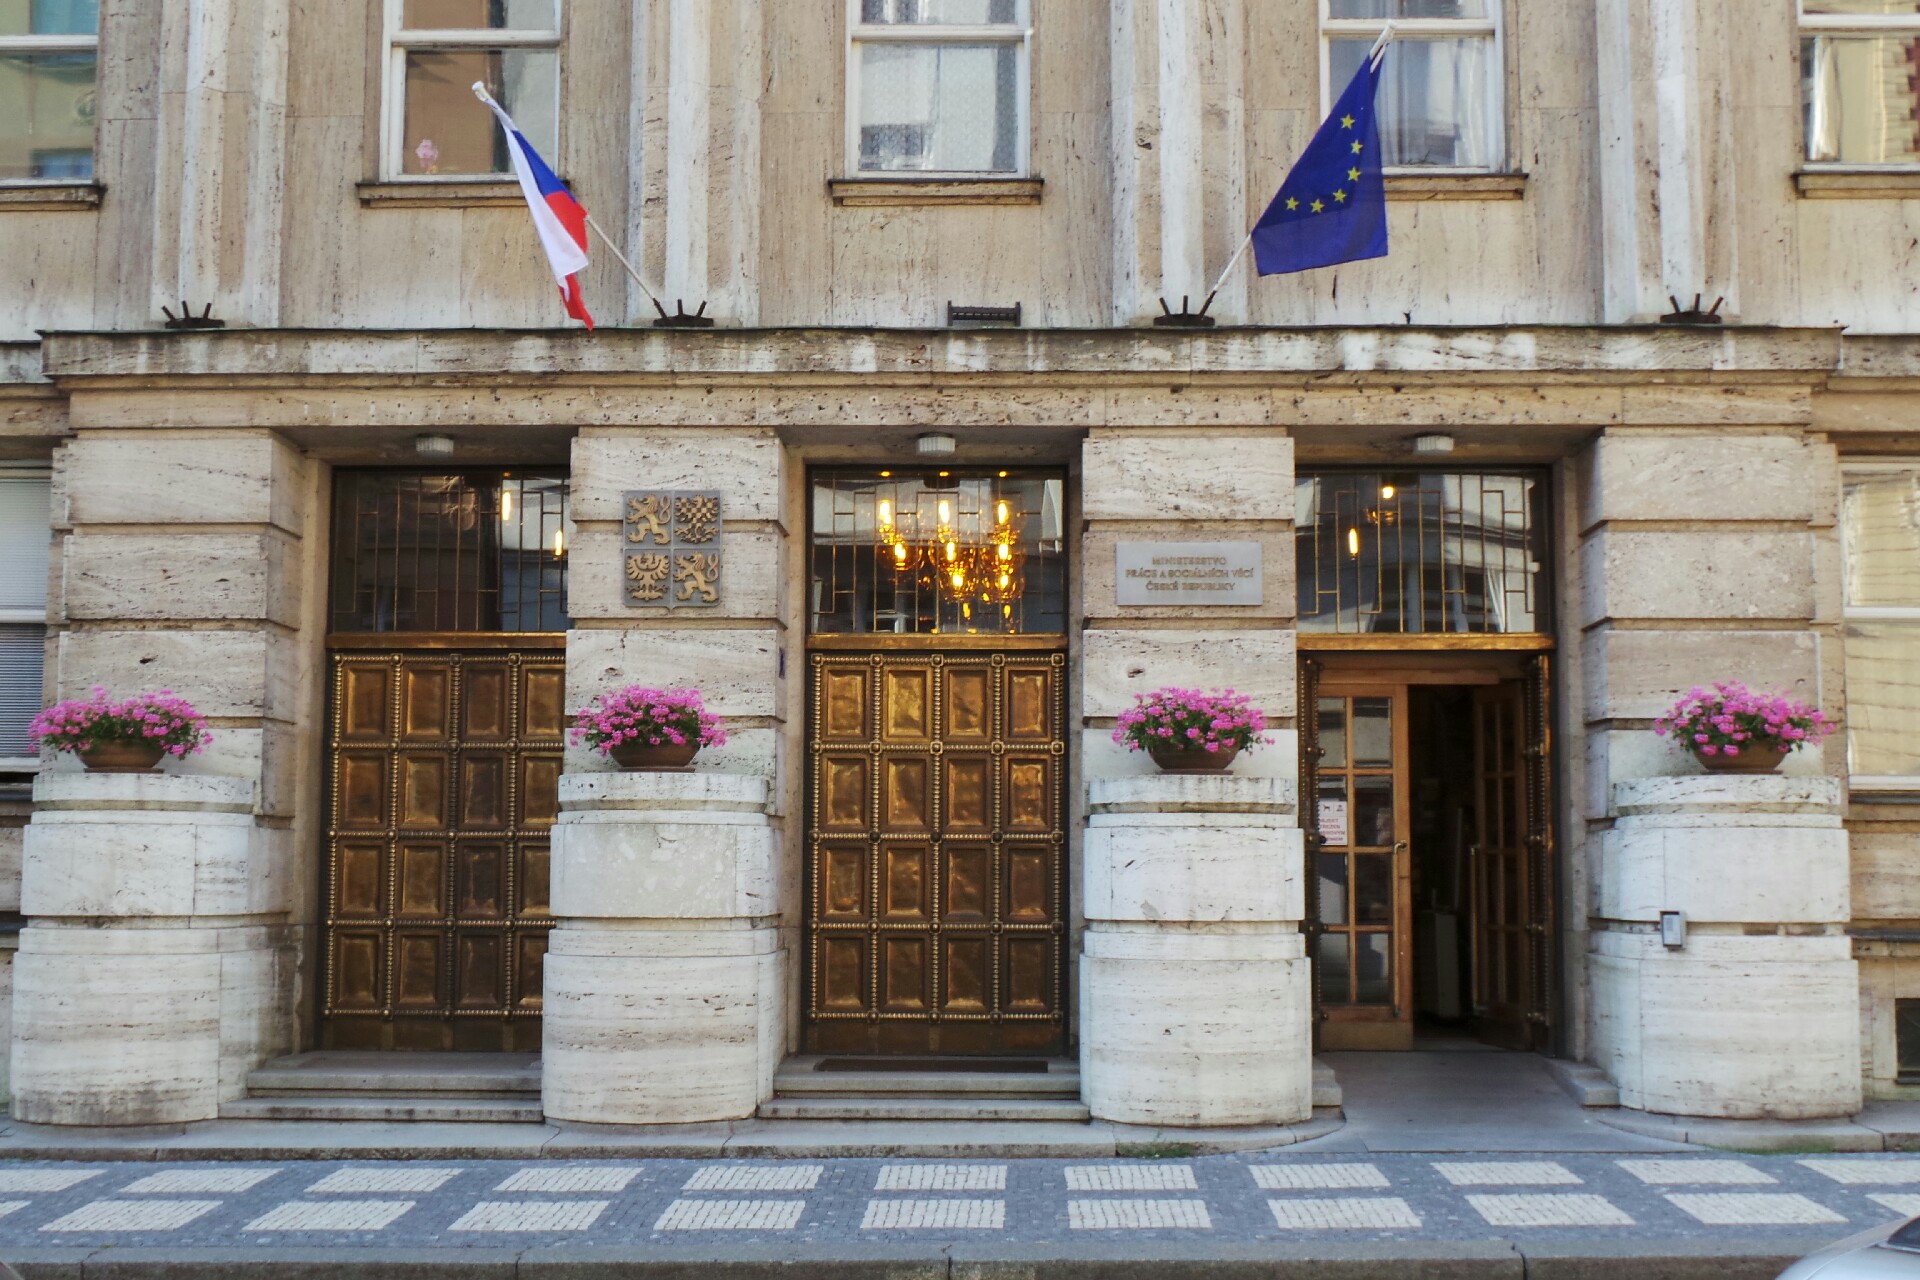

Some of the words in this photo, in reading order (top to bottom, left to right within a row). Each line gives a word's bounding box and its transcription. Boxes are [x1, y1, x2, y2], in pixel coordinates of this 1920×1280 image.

[1152, 557, 1226, 565] MINISTERSTVO
[1125, 568, 1157, 578] PRÁCE
[1160, 570, 1166, 578] A
[1167, 568, 1229, 578] SOCIÁLNÍCH
[1232, 567, 1254, 578] VĚCÍ
[1146, 580, 1178, 591] ČESKÉ
[1181, 582, 1235, 591] REPUBLIKY
